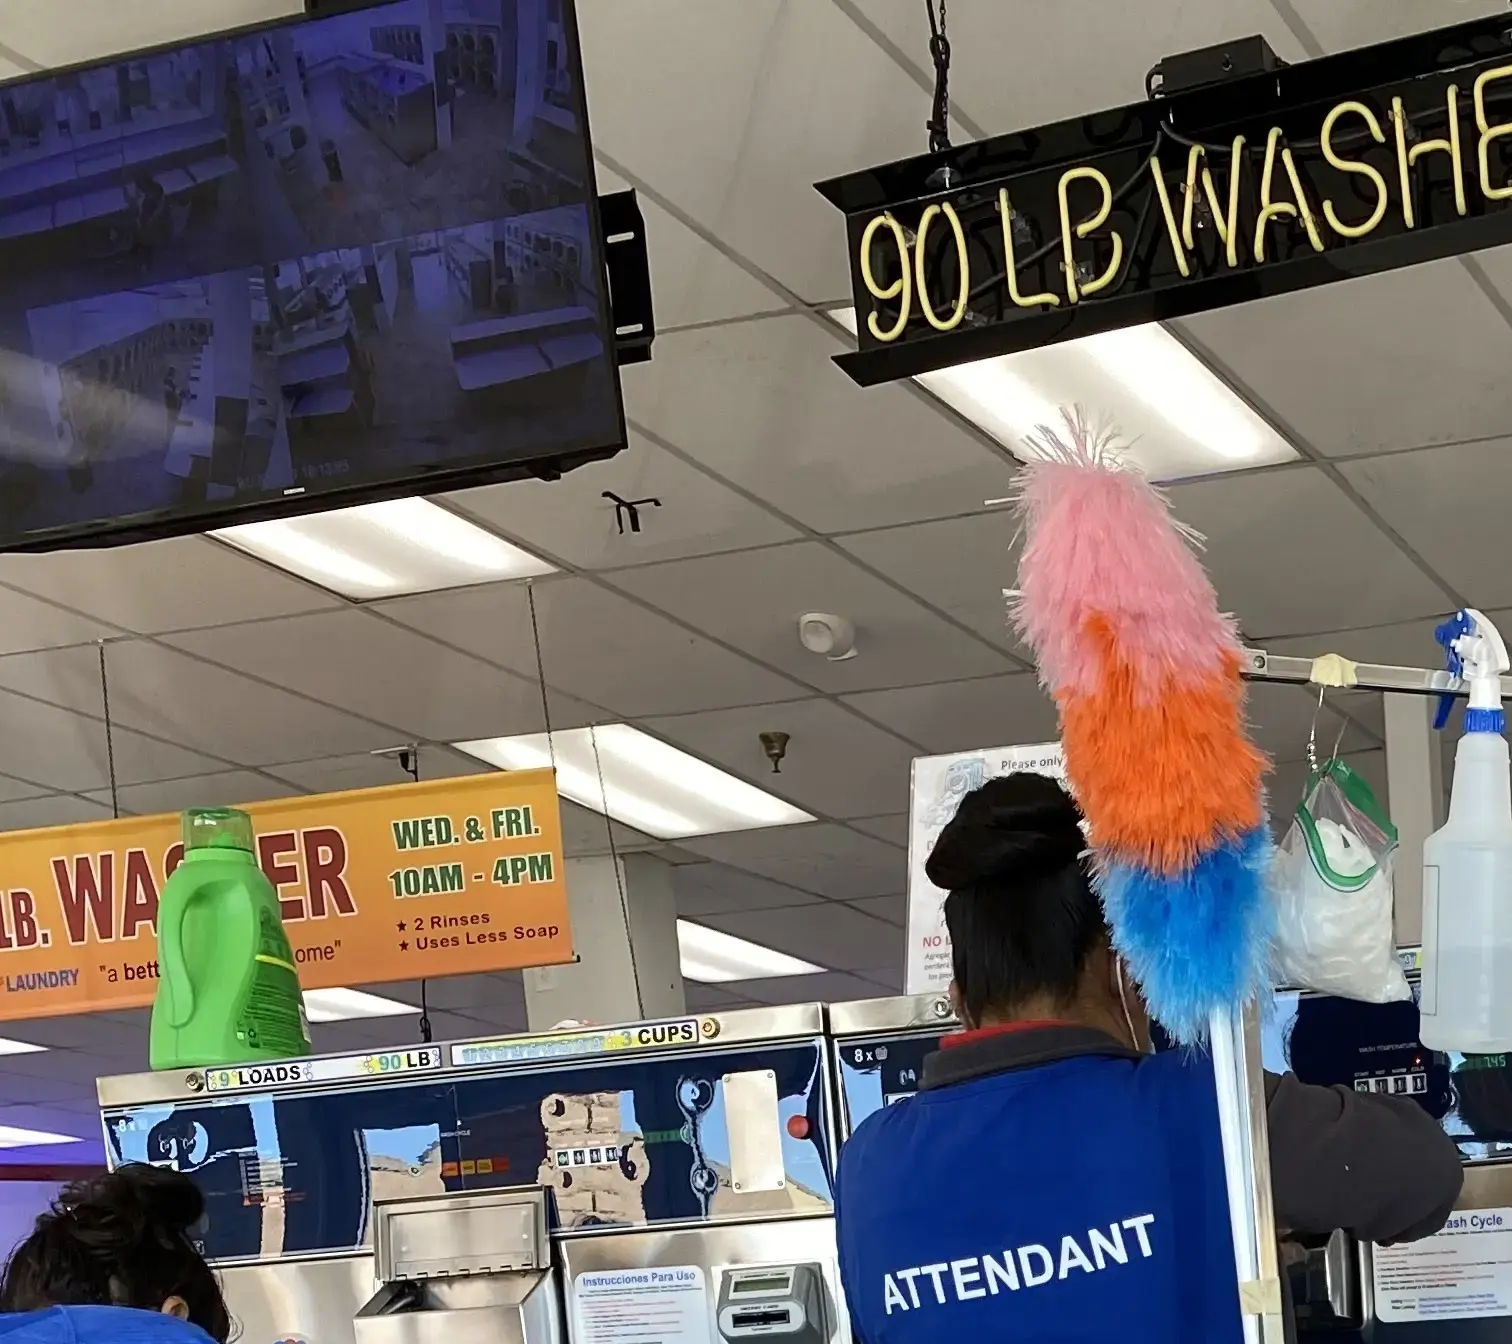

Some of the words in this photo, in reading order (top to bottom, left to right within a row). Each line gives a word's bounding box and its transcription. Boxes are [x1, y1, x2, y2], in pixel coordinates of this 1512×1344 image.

[860, 201, 970, 342] 90
[1000, 166, 1122, 306] LB
[1001, 760, 1036, 770] Please
[1040, 755, 1062, 767] only
[393, 816, 459, 849] WED.
[465, 817, 484, 842] &
[492, 807, 539, 838] FRI.
[52, 827, 357, 945] WAER
[390, 864, 463, 897] 10AM
[493, 854, 553, 885] 4PM
[414, 918, 424, 930] 2
[430, 913, 490, 929] Rinses
[416, 935, 460, 950] Uses
[465, 929, 507, 945] Less
[514, 925, 559, 940] Soap
[923, 936, 941, 948] NO
[123, 961, 160, 981] bett
[295, 940, 342, 963] ome"
[6, 968, 79, 992] LAUNDRY
[638, 1024, 693, 1045] CUPS
[854, 1048, 863, 1062] 8
[219, 1072, 229, 1087] 9
[238, 1065, 301, 1086] LOADS
[378, 1055, 401, 1072] 90
[406, 1051, 431, 1069] LB
[1447, 1216, 1467, 1228] ash
[1471, 1214, 1503, 1230] Cycle
[884, 1214, 1154, 1315] ATTENDANT
[583, 1274, 648, 1287] Instrucciones
[651, 1272, 673, 1282] Para
[676, 1270, 696, 1280] Uso
